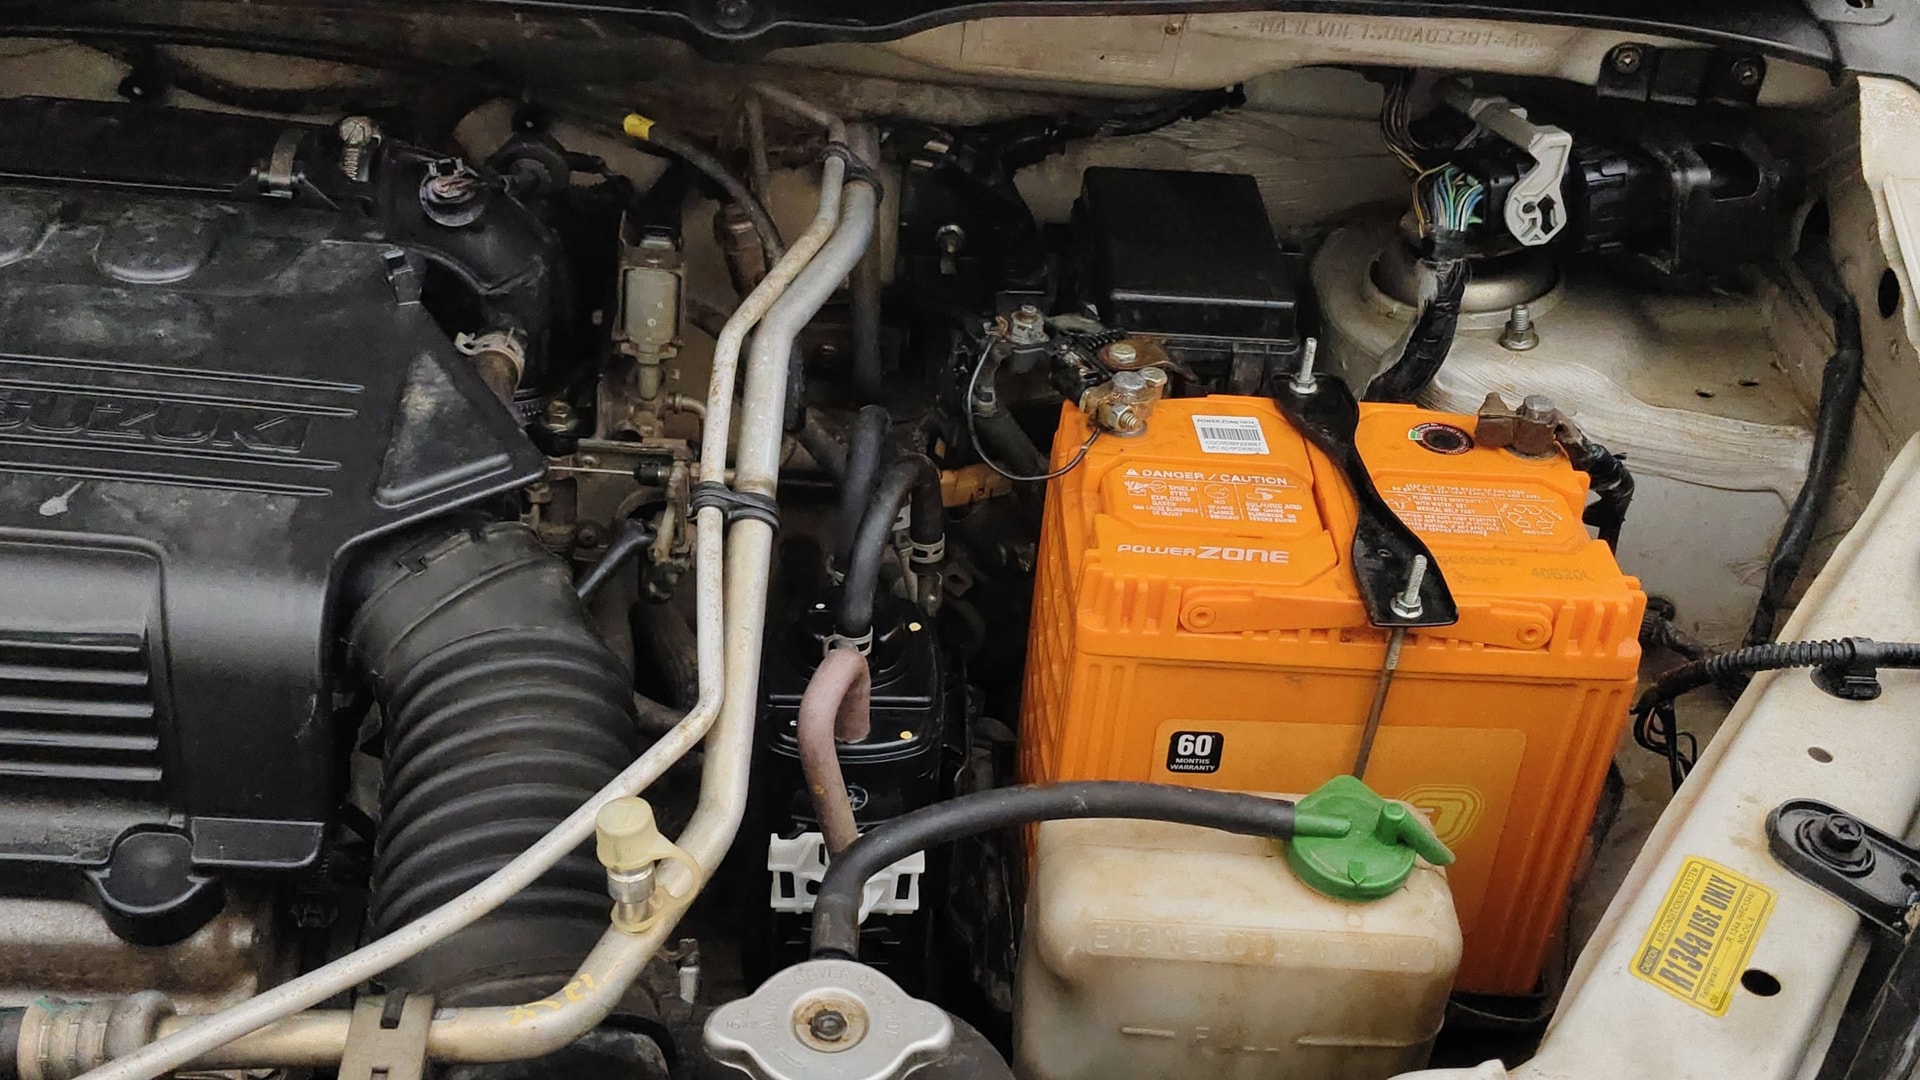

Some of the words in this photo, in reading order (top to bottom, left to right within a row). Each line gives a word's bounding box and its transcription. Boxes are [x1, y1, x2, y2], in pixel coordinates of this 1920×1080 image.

[0, 394, 312, 453] SUZUKI
[1142, 469, 1204, 480] DANGER
[1220, 474, 1288, 485] CAUTION
[1177, 734, 1212, 756] 60
[1700, 874, 1737, 911] ONLY
[1640, 949, 1660, 972] CAUTION
[1656, 930, 1666, 943] AIR
[1662, 888, 1688, 932] CONDITIONING
[1684, 867, 1698, 890] SYSTEM
[1688, 904, 1723, 938] USE
[1094, 925, 1201, 956] ENGINE
[1658, 931, 1713, 992] R134a
[1701, 966, 1720, 1000] Refrigerant
